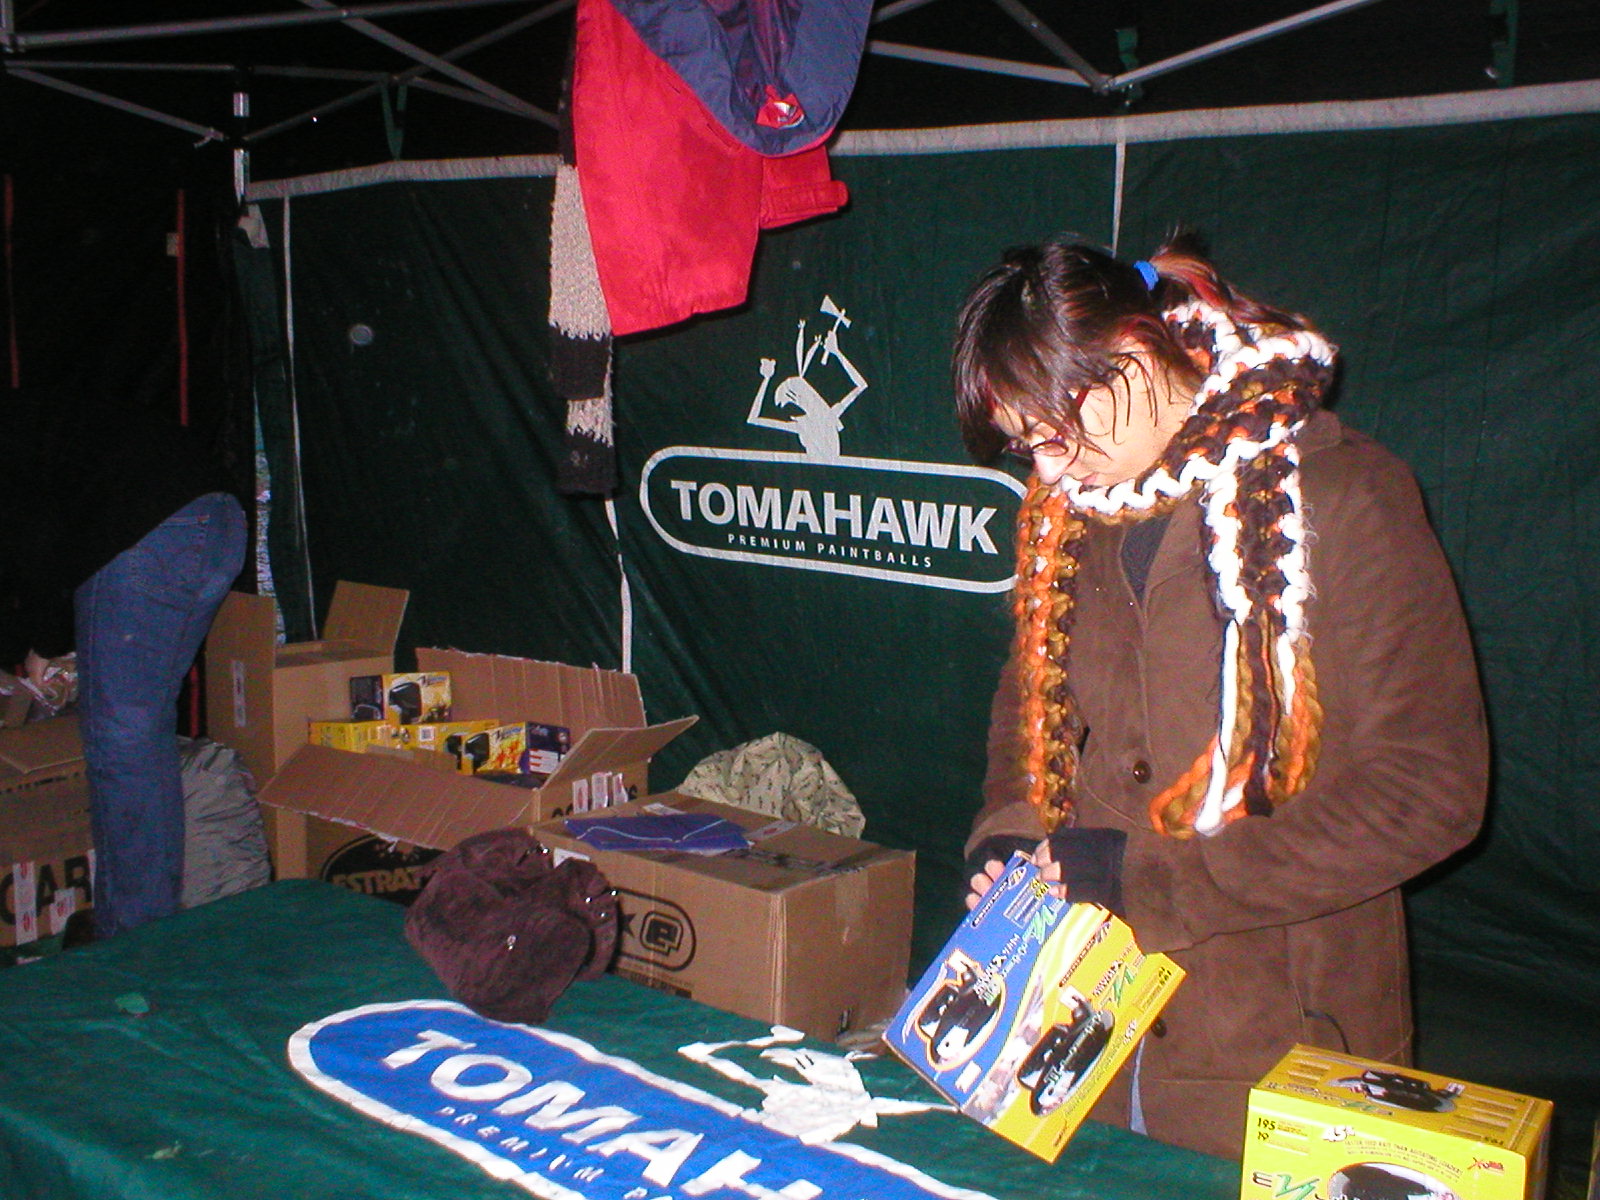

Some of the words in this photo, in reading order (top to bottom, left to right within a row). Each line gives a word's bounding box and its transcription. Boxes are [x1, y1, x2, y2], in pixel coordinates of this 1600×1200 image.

[670, 480, 999, 556] TOMAHAWK
[727, 533, 806, 553] PREMIUM
[817, 543, 934, 570] PAINTBALLS
[1258, 1117, 1276, 1131] 195
